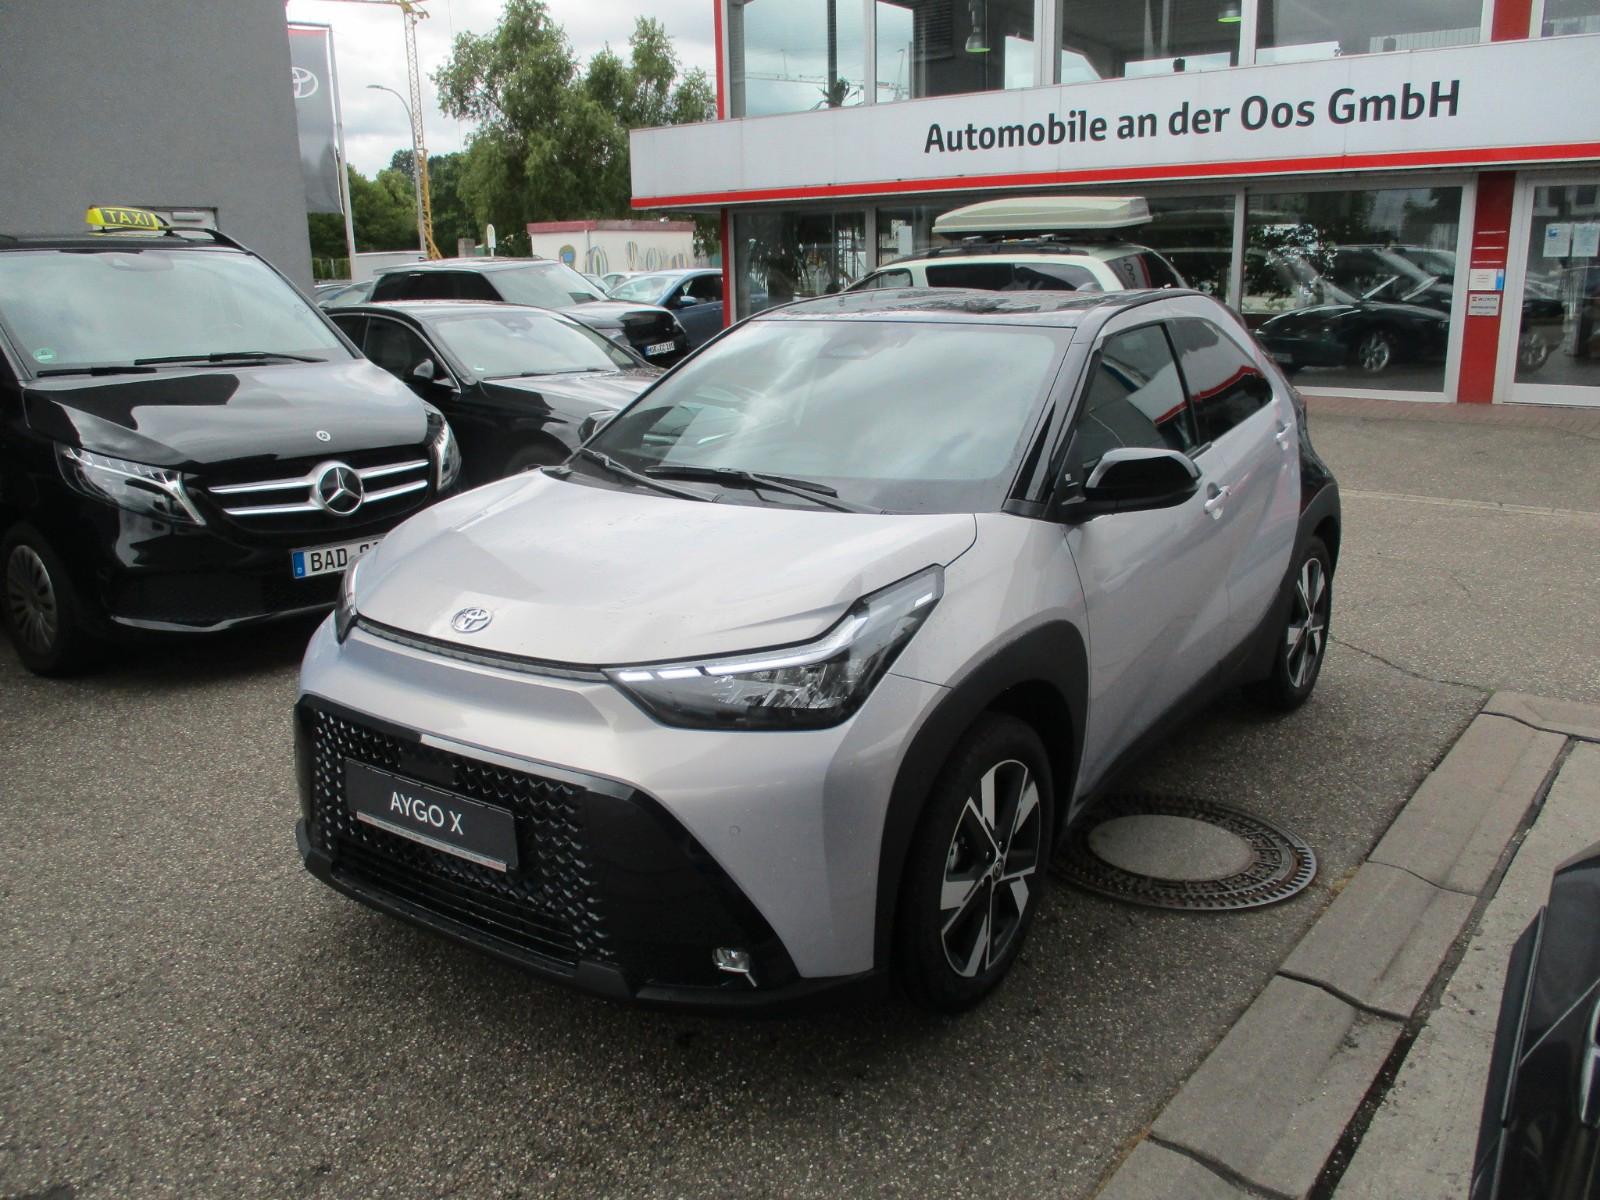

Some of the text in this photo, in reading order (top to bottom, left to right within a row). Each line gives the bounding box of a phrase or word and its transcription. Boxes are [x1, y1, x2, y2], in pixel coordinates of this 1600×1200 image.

[924, 79, 1460, 153] Automobile an der Oos GmbH
[105, 210, 150, 226] TAXI
[310, 547, 348, 572] BAD
[390, 791, 444, 828] AYGO
[449, 810, 464, 835] X
